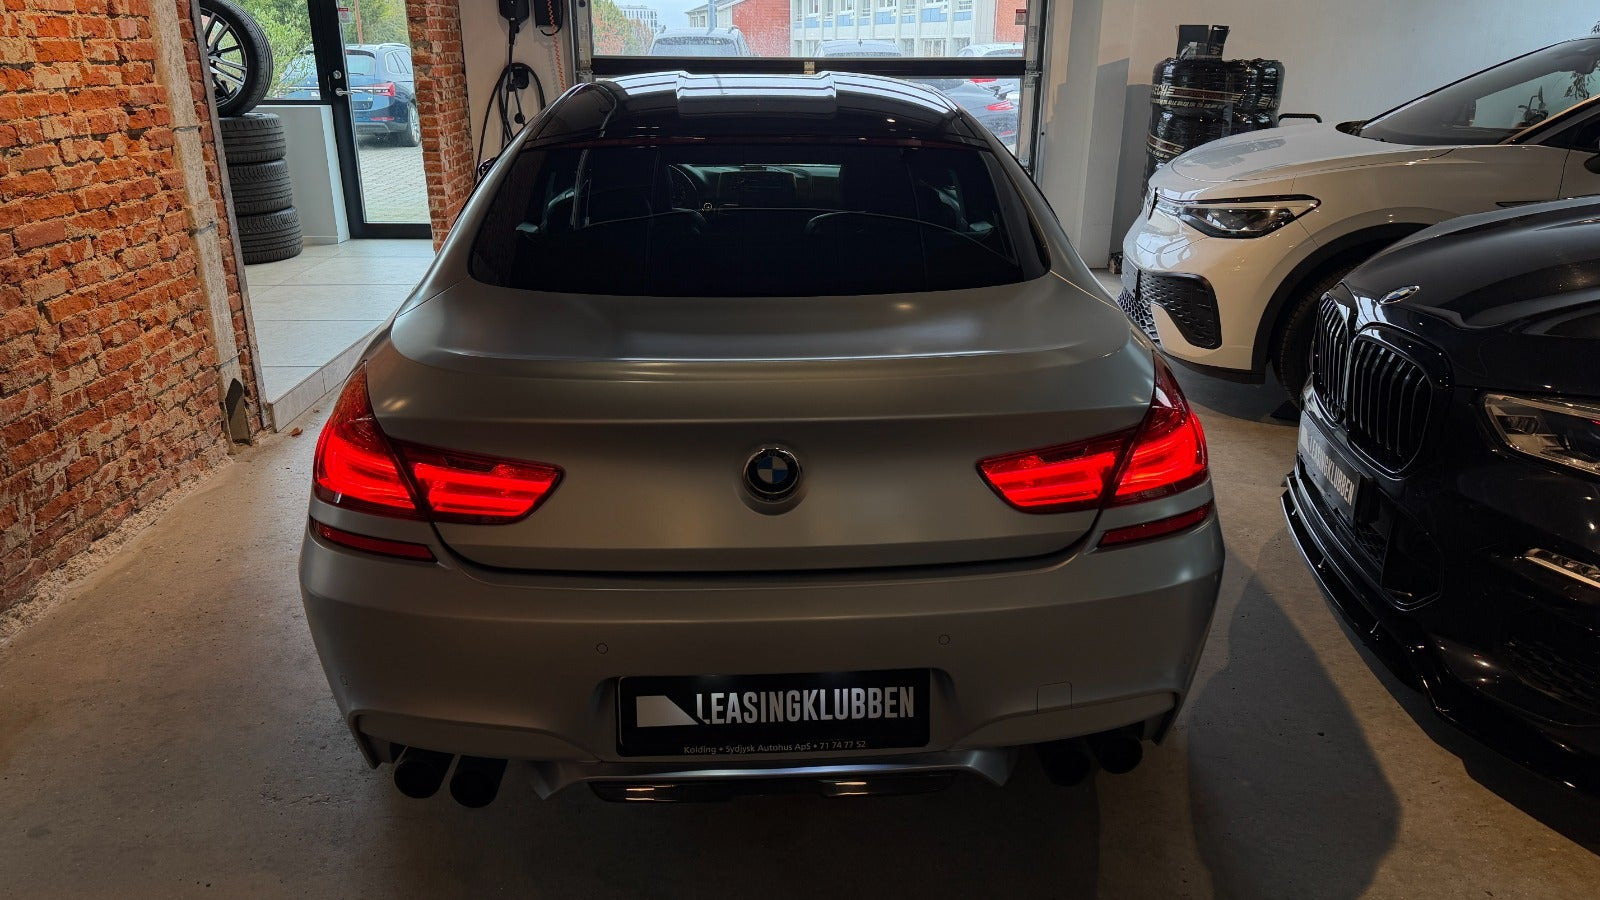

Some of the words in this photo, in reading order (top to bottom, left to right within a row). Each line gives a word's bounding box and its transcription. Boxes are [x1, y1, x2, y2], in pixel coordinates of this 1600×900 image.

[696, 686, 914, 725] LEASINGKLUBBEN
[683, 746, 717, 755] Kolding
[725, 745, 755, 754] Sydjysk
[757, 743, 793, 752] Autohus
[795, 742, 811, 753] ApS
[819, 742, 829, 750] 71
[832, 741, 842, 749] 74
[844, 741, 854, 749] 77
[856, 740, 866, 748] 52
